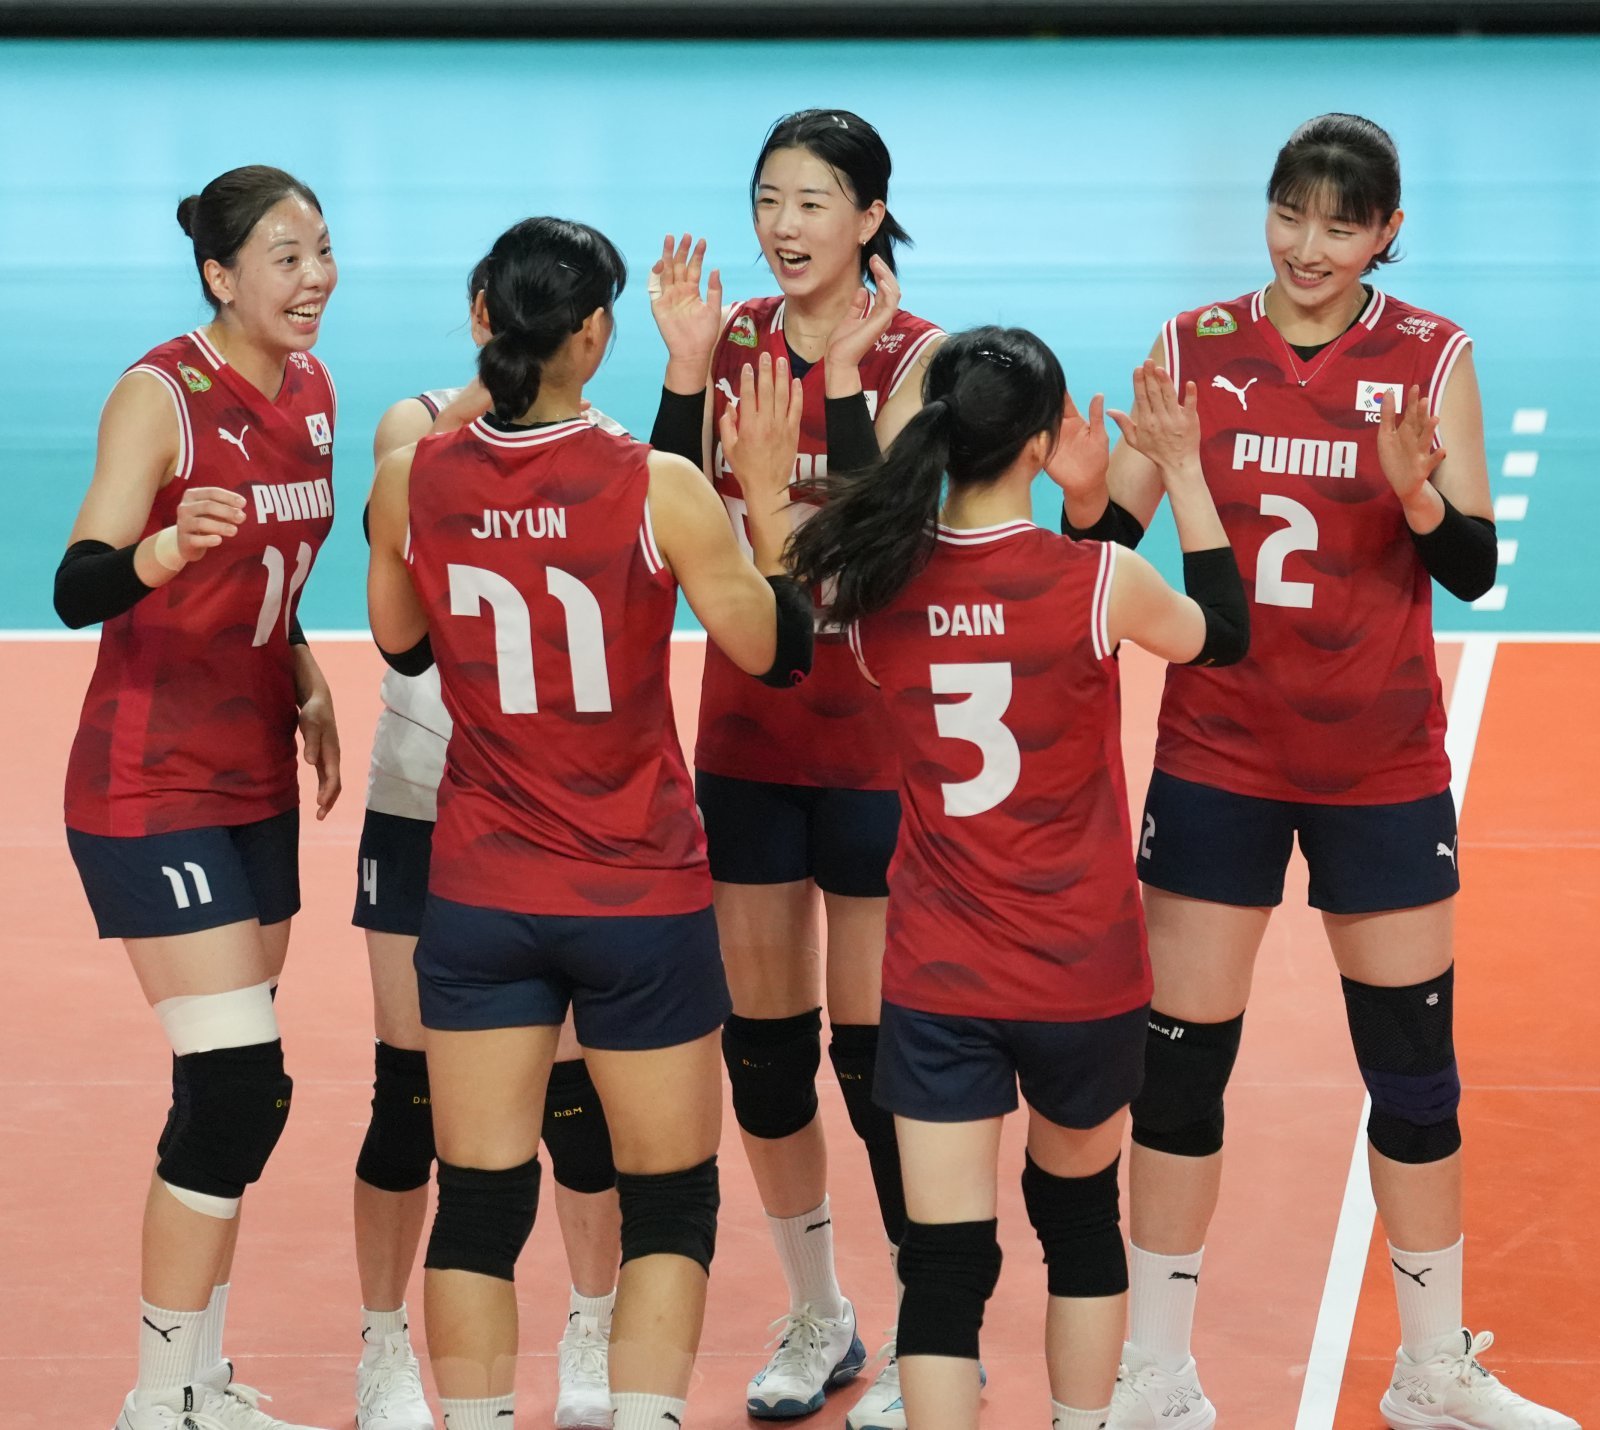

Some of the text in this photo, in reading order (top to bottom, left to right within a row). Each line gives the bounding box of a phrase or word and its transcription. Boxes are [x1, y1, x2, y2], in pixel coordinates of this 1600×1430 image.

[1364, 411, 1382, 423] KO
[1232, 433, 1358, 479] PUMA
[251, 478, 334, 524] PUMA
[471, 507, 567, 539] JIYUN
[1254, 493, 1319, 609] 2
[251, 541, 313, 647] 11
[446, 563, 613, 714] 71
[927, 603, 1006, 637] DAIN
[929, 661, 1021, 818] 3
[1141, 812, 1156, 860] 2
[161, 861, 213, 909] 11
[362, 857, 378, 906] 4
